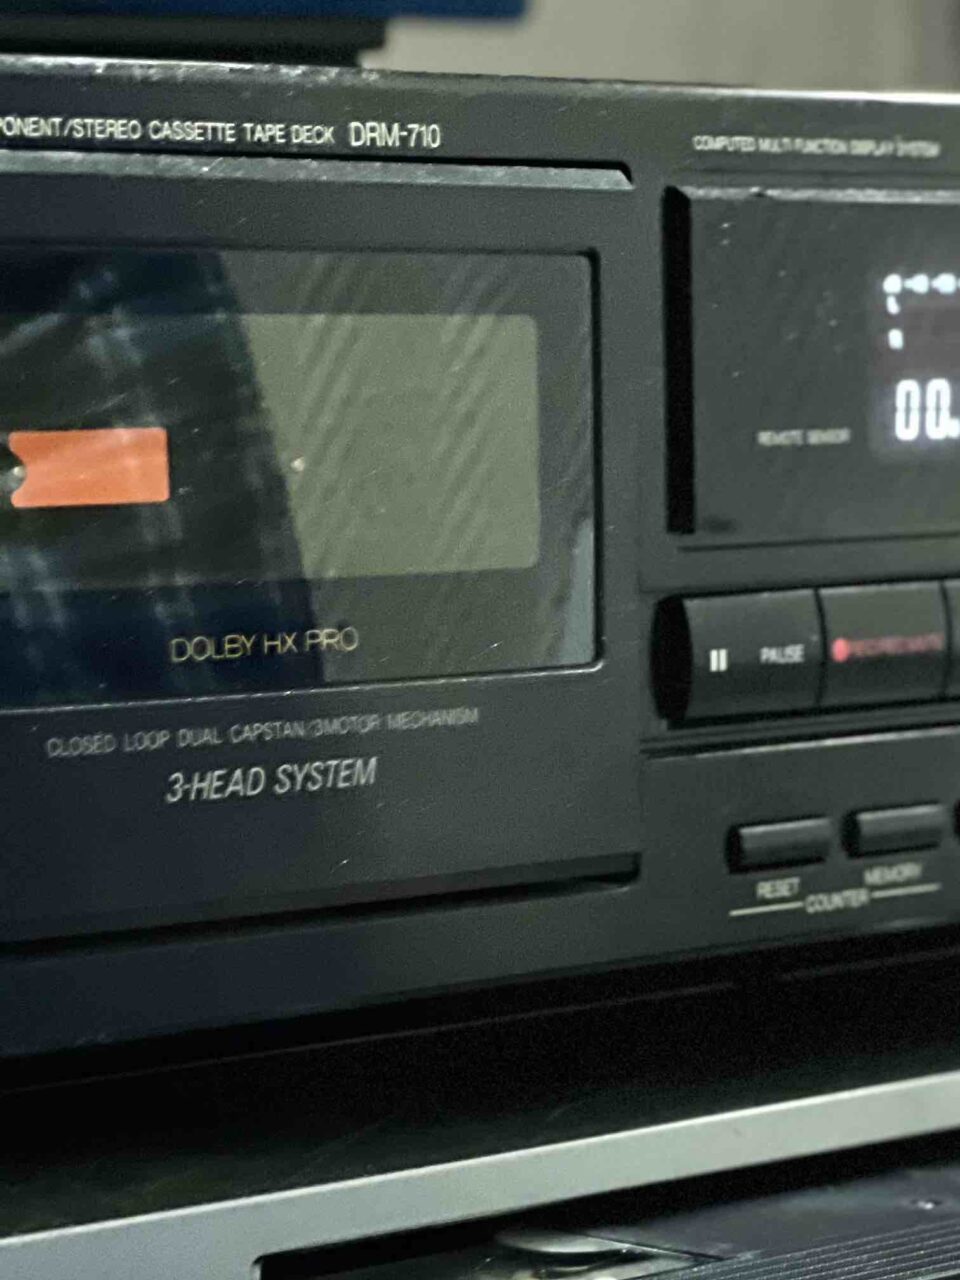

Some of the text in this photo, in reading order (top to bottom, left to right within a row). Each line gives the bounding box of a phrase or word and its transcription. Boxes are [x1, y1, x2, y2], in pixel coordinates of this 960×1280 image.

[148, 119, 236, 144] CASSETTE
[244, 121, 287, 144] TAPE
[291, 123, 335, 146] DECK
[348, 120, 441, 149] DRM-710
[171, 625, 361, 664] DOLBY HX PRO
[760, 643, 805, 664] PAUSE
[46, 732, 117, 759] CLOSED
[122, 728, 170, 752] LOOP
[176, 725, 224, 748] DUAL
[166, 756, 379, 802] 3-HEAD SYSTEM
[755, 876, 801, 899] RESET
[862, 861, 923, 886] MEMORY
[804, 887, 870, 914] COUNTER
